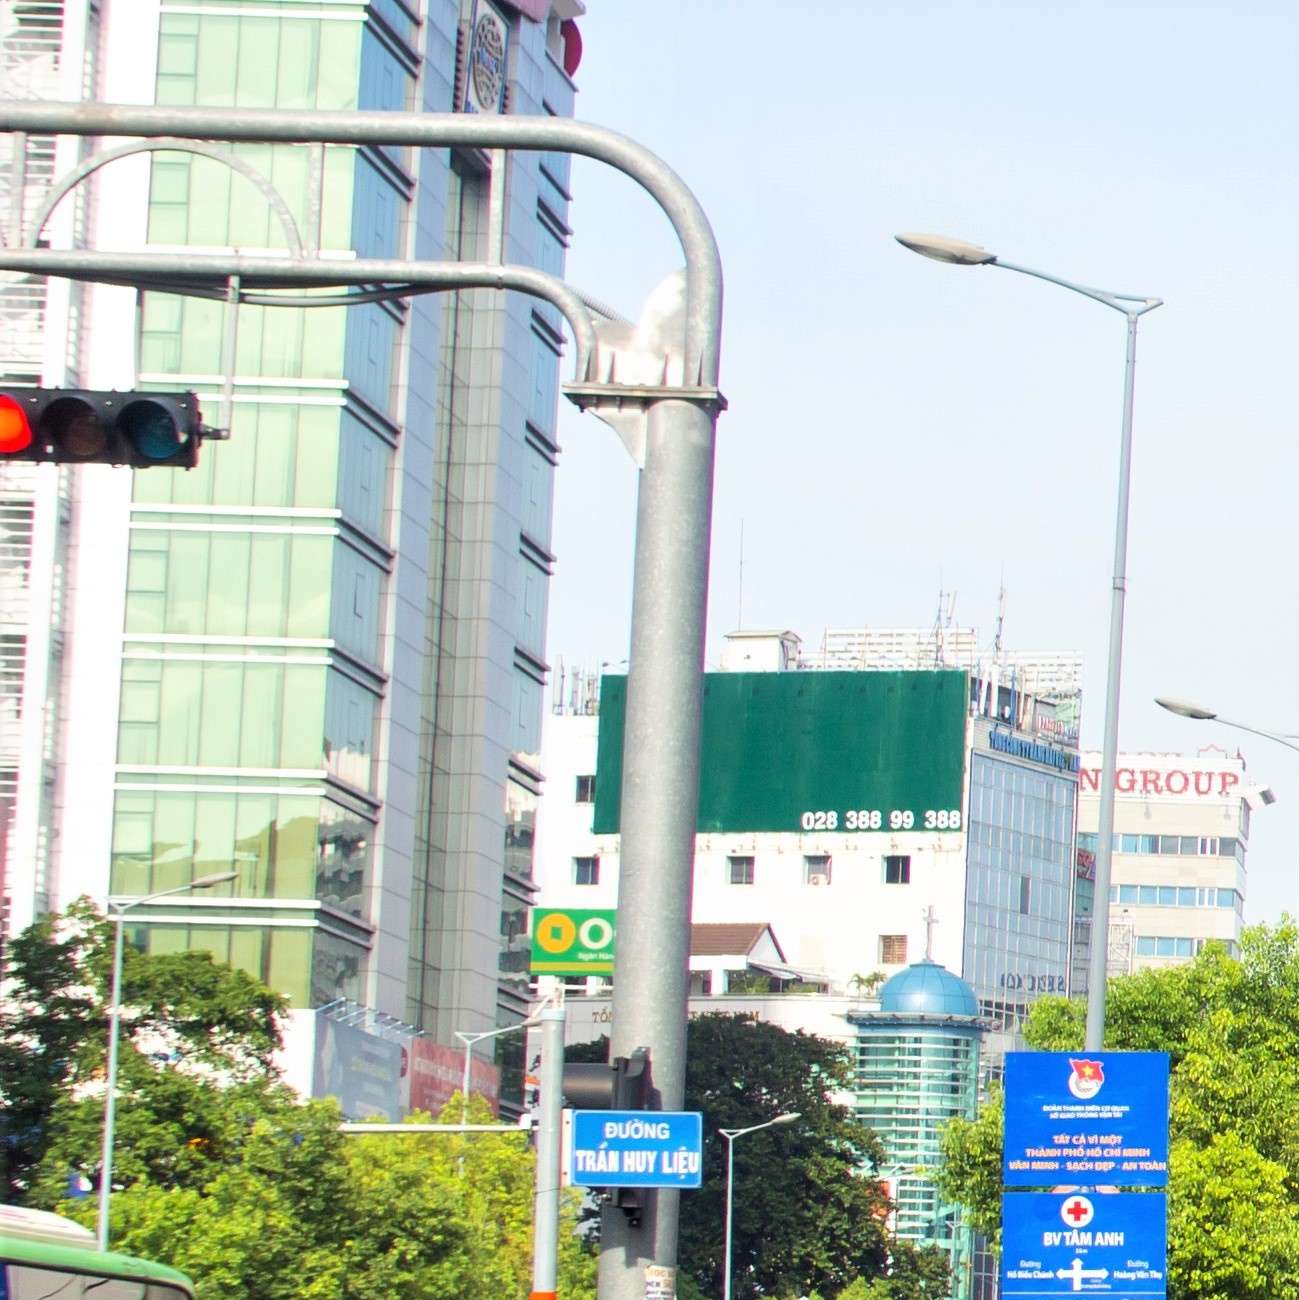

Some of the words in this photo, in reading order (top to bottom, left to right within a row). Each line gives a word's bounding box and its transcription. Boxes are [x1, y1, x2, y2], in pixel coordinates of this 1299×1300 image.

[1115, 767, 1239, 797] GROUP
[802, 811, 838, 830] 028
[846, 810, 882, 830] 388
[890, 810, 914, 830] 99
[924, 810, 961, 830] 388
[605, 1118, 670, 1139] ĐƯỜNG
[622, 1150, 658, 1173] HUY
[661, 1146, 699, 1179] LIỆU
[1121, 1162, 1137, 1171] AN
[1043, 1232, 1062, 1246] BV
[1064, 1228, 1092, 1246] TÂM
[1094, 1232, 1124, 1246] ANH
